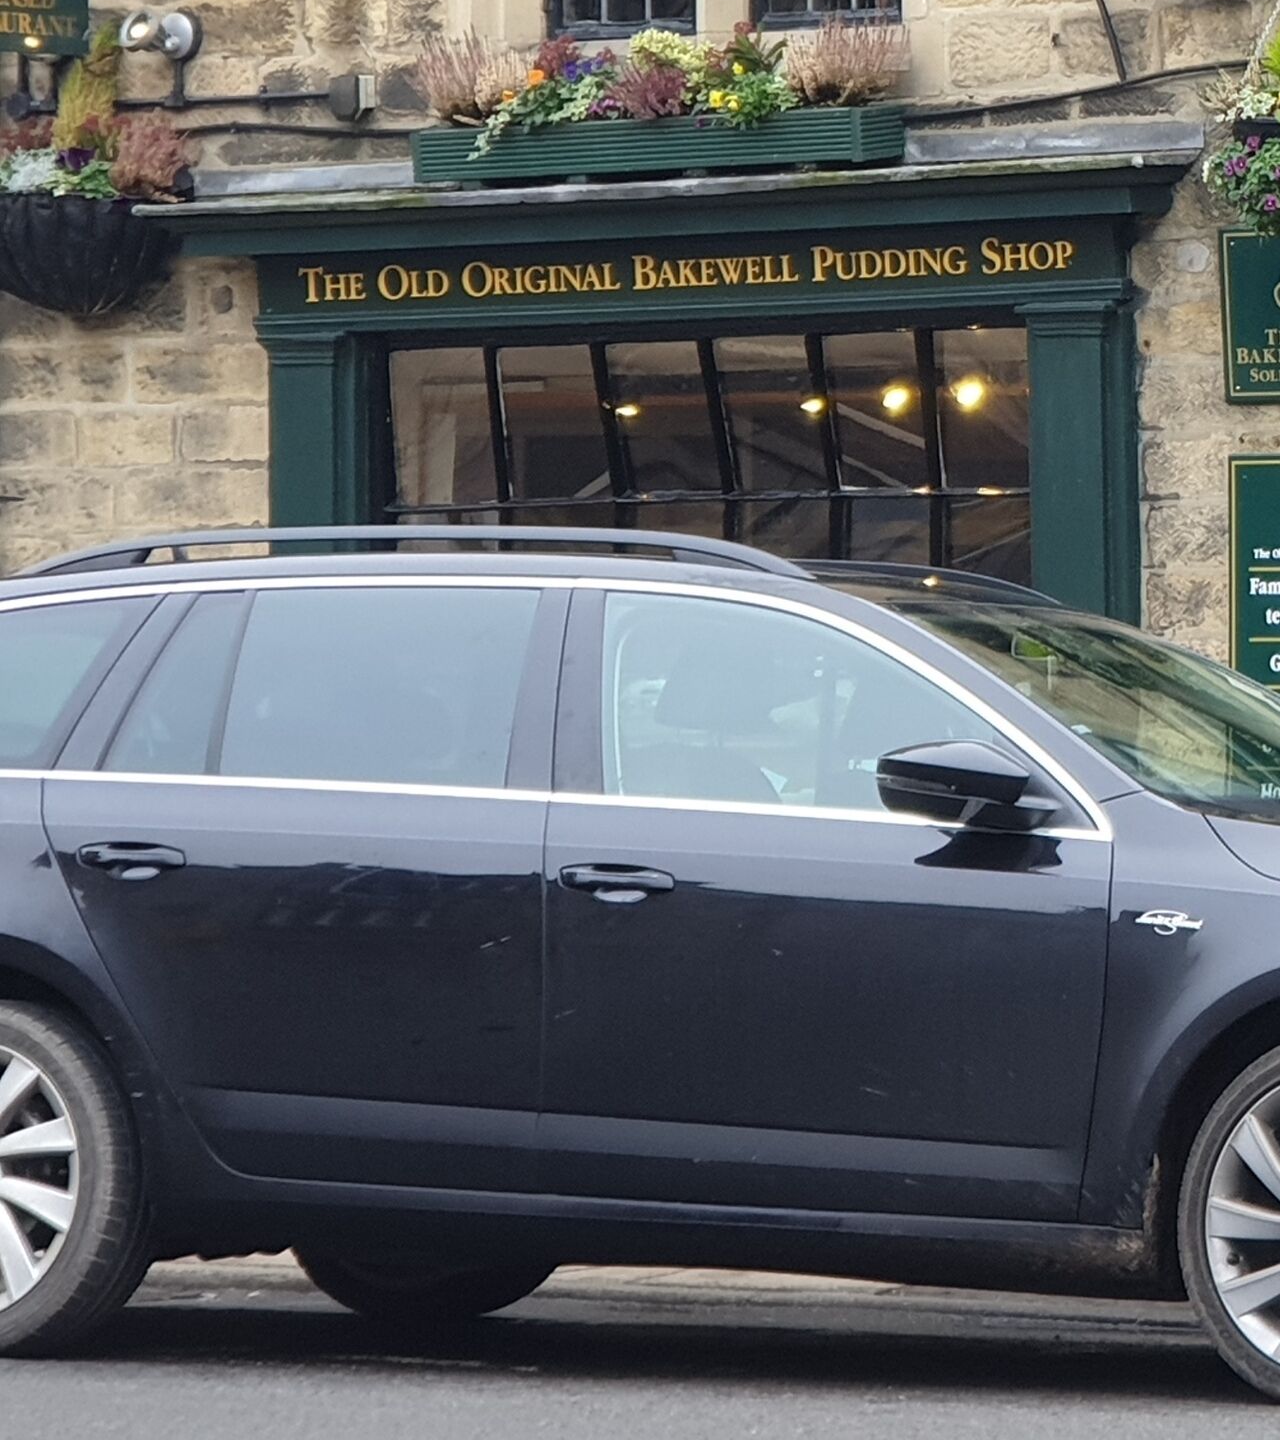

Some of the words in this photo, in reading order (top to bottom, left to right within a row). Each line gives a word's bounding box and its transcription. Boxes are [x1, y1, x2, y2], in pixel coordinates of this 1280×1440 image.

[0, 11, 77, 37] URANT
[299, 268, 365, 303] THE
[377, 266, 448, 300] OLD
[461, 261, 620, 299] ORIGINAL
[633, 255, 799, 290] BAKEWELL
[811, 245, 966, 283] PUDDING
[982, 238, 1074, 273] SHOP
[1254, 549, 1269, 559] The
